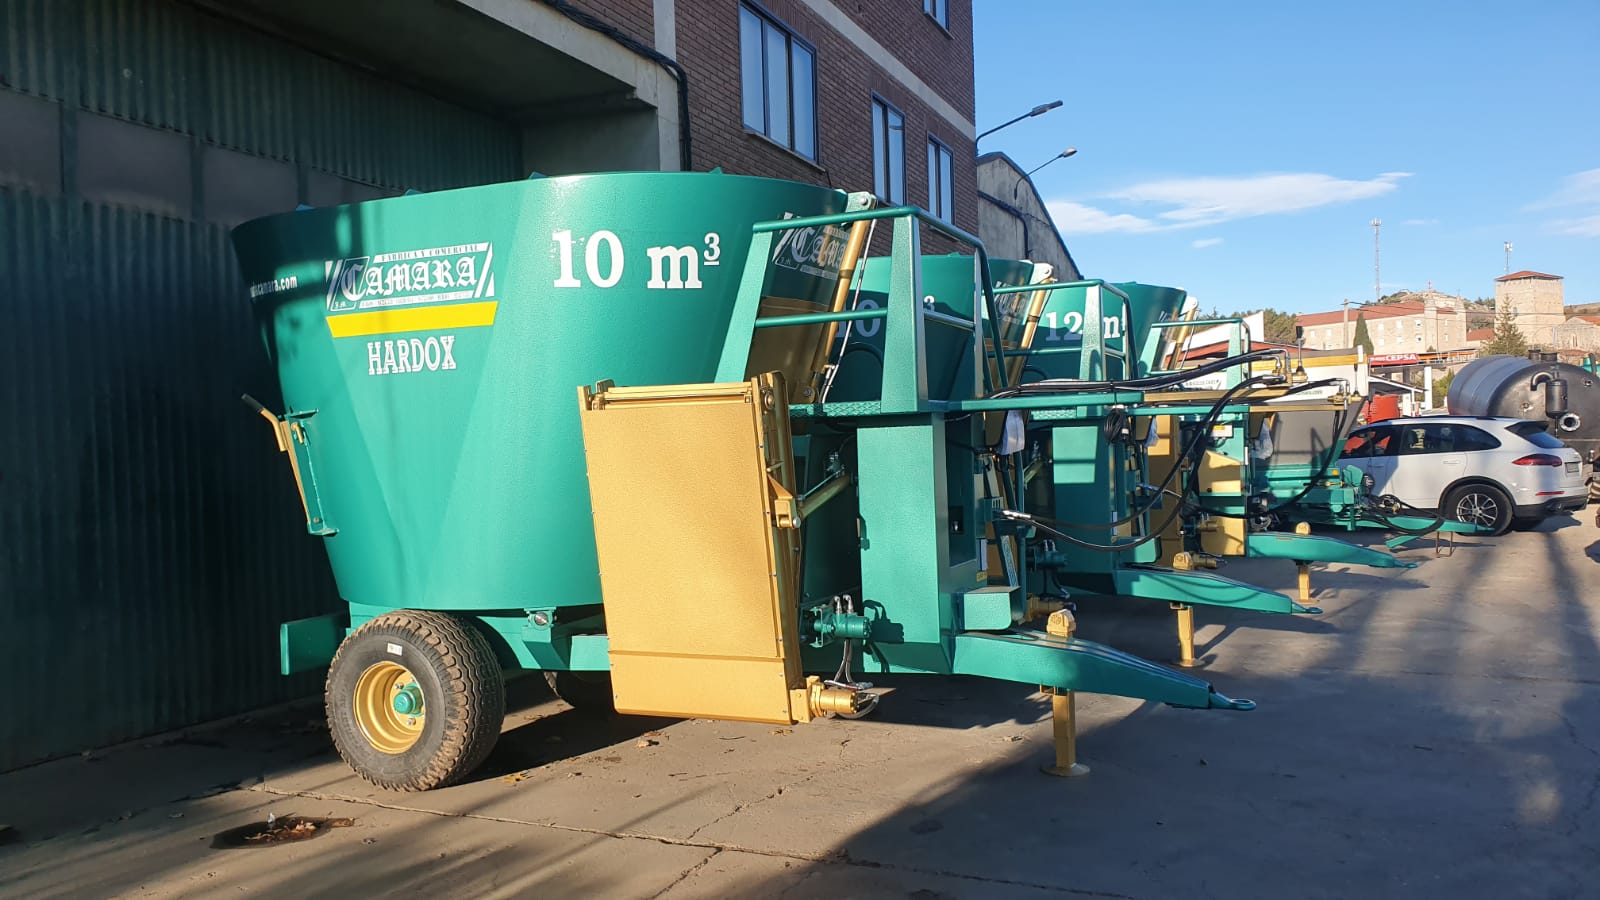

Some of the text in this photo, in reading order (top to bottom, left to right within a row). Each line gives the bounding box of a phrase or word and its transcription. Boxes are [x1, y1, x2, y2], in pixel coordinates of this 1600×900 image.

[341, 255, 478, 302] CAMARA
[551, 229, 625, 288] 10
[1045, 311, 1083, 341] 12
[367, 335, 457, 375] HARDOX
